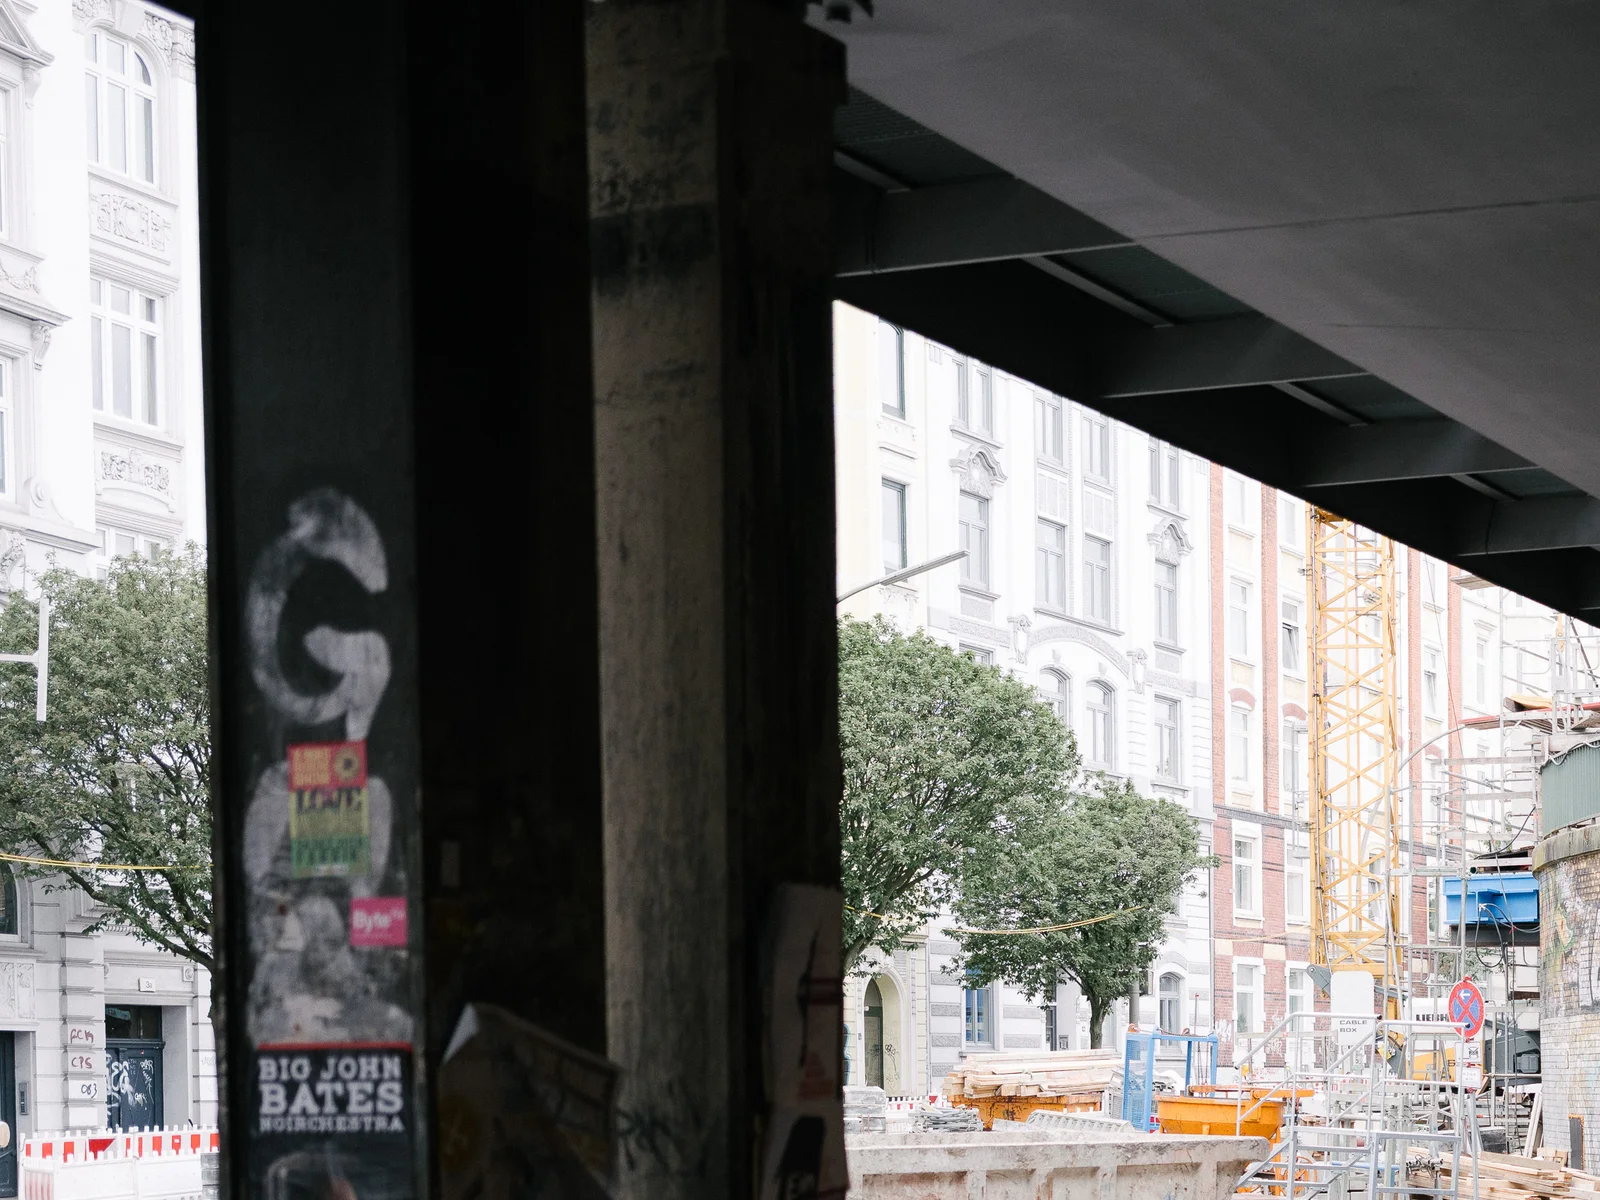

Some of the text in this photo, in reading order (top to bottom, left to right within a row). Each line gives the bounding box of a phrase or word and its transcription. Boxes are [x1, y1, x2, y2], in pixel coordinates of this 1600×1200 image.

[258, 1054, 402, 1082] BIG JOHN
[258, 1081, 404, 1116] BATES
